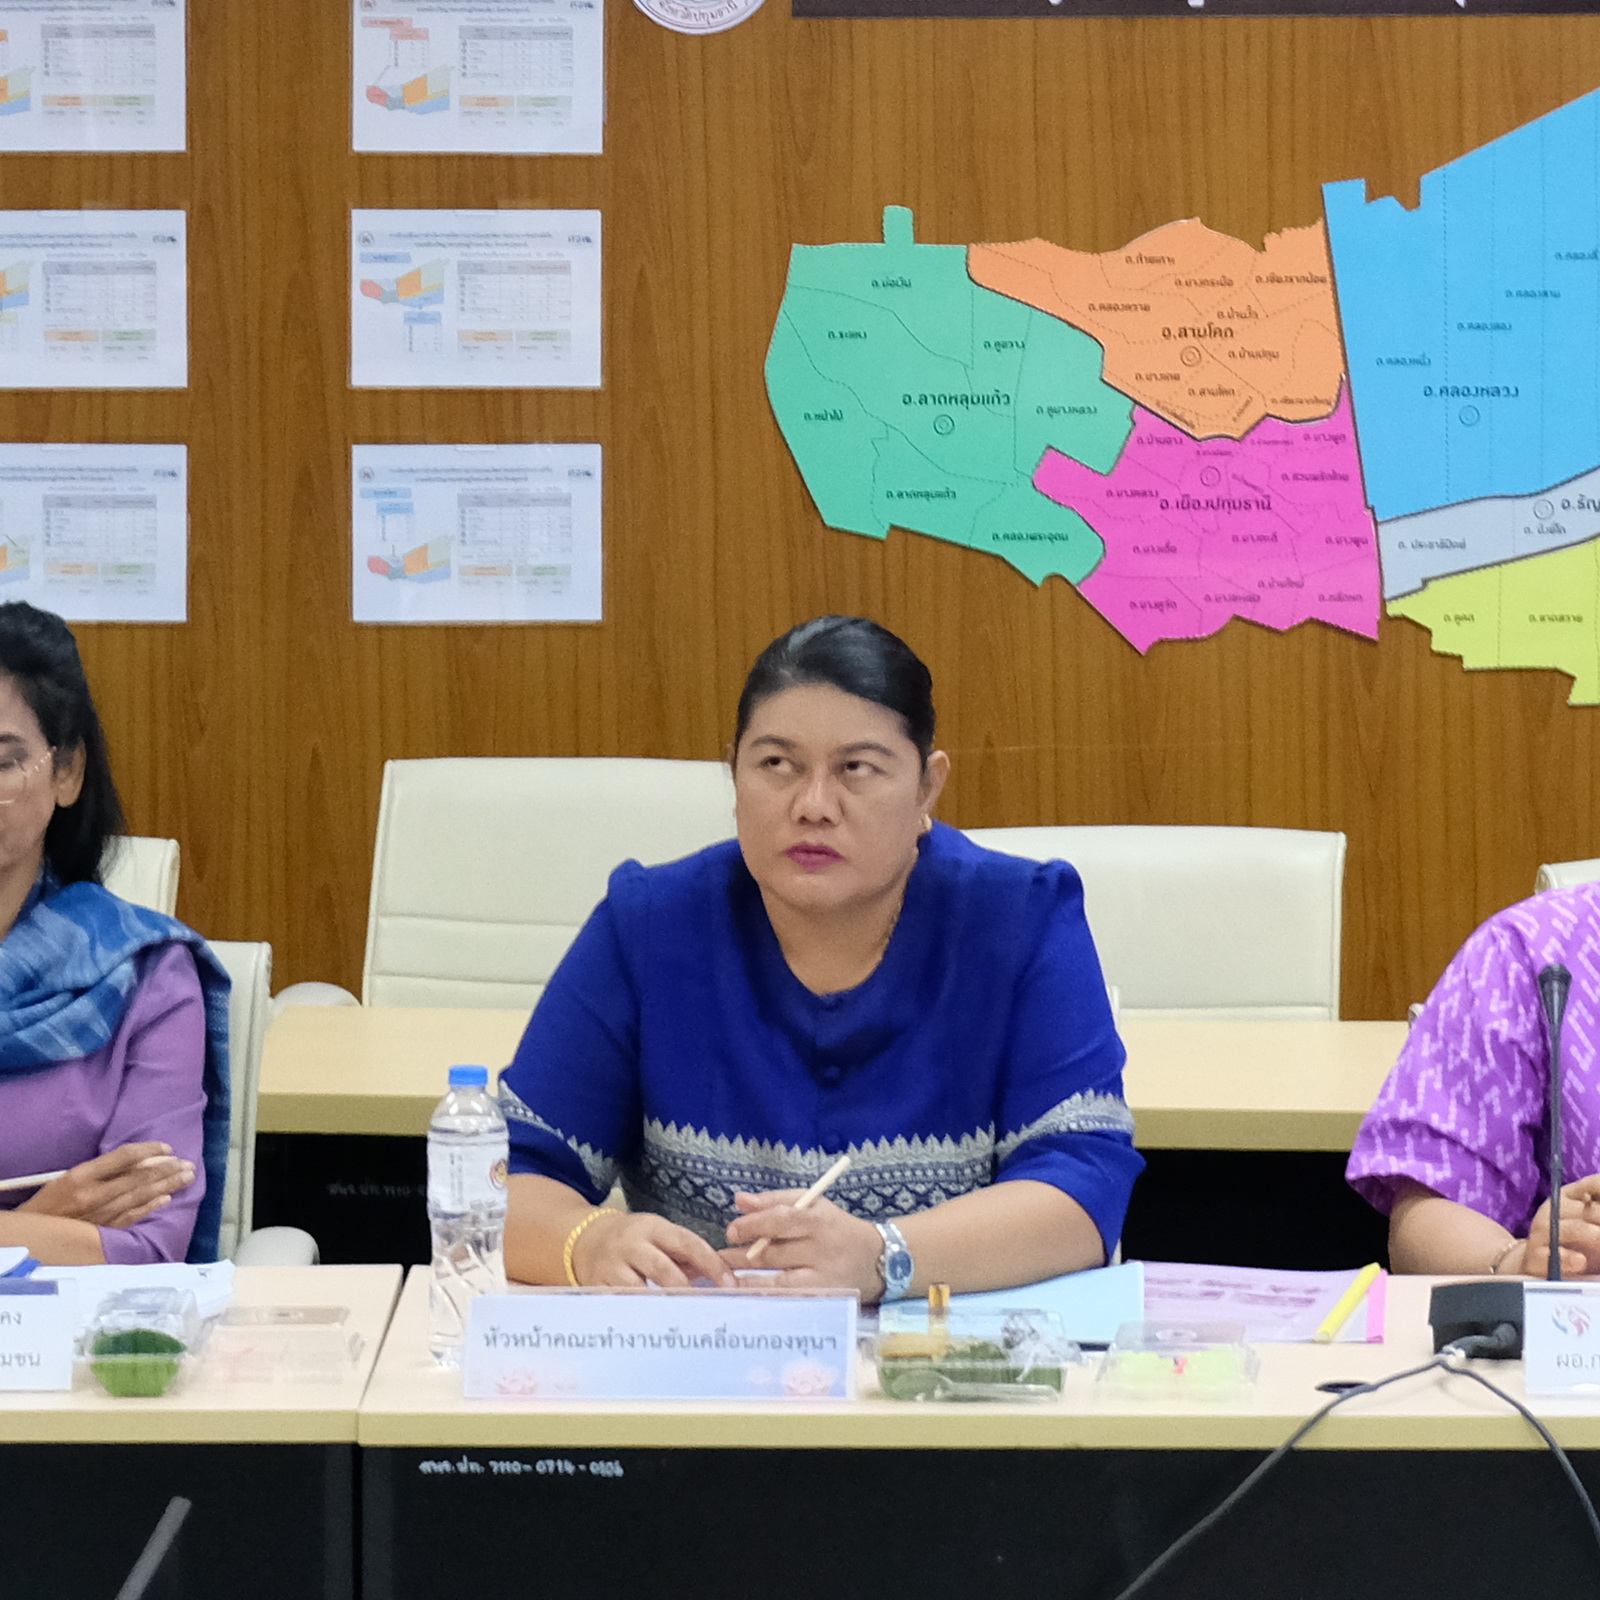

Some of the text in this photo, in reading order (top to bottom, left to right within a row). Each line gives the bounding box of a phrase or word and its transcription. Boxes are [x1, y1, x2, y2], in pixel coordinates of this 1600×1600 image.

[483, 1323, 838, 1356] หัวหน้าคณะทำงานขับเคลื่อนกองทุนฯ
